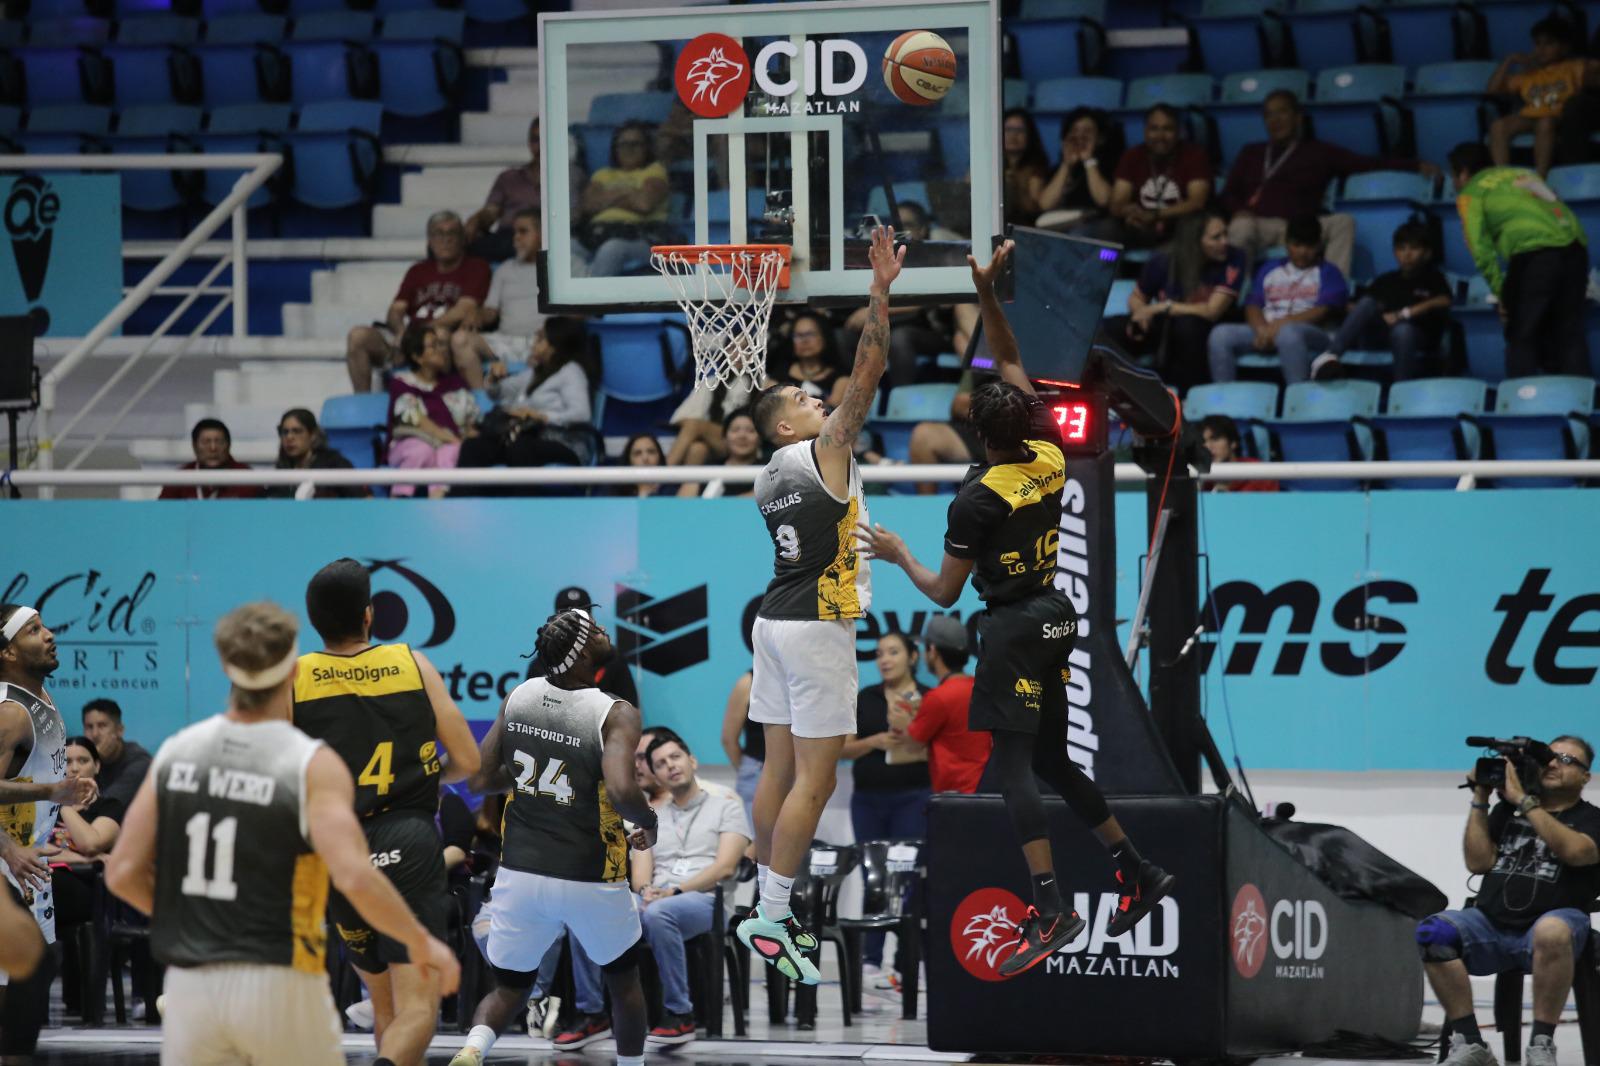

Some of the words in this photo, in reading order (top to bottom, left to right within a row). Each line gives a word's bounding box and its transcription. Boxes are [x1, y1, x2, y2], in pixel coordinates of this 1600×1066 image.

[754, 39, 868, 97] CID
[765, 101, 860, 115] MAZATLAN
[775, 525, 801, 561] 9
[1008, 562, 1026, 575] LG
[507, 722, 563, 743] STAFFORD
[565, 735, 581, 748] JR
[167, 762, 199, 793] EL
[358, 741, 395, 796] 4
[424, 760, 440, 776] LG
[513, 748, 575, 807] 24
[181, 812, 238, 900] 11
[1270, 899, 1328, 960] CID
[1046, 955, 1180, 978] MAZATLAN
